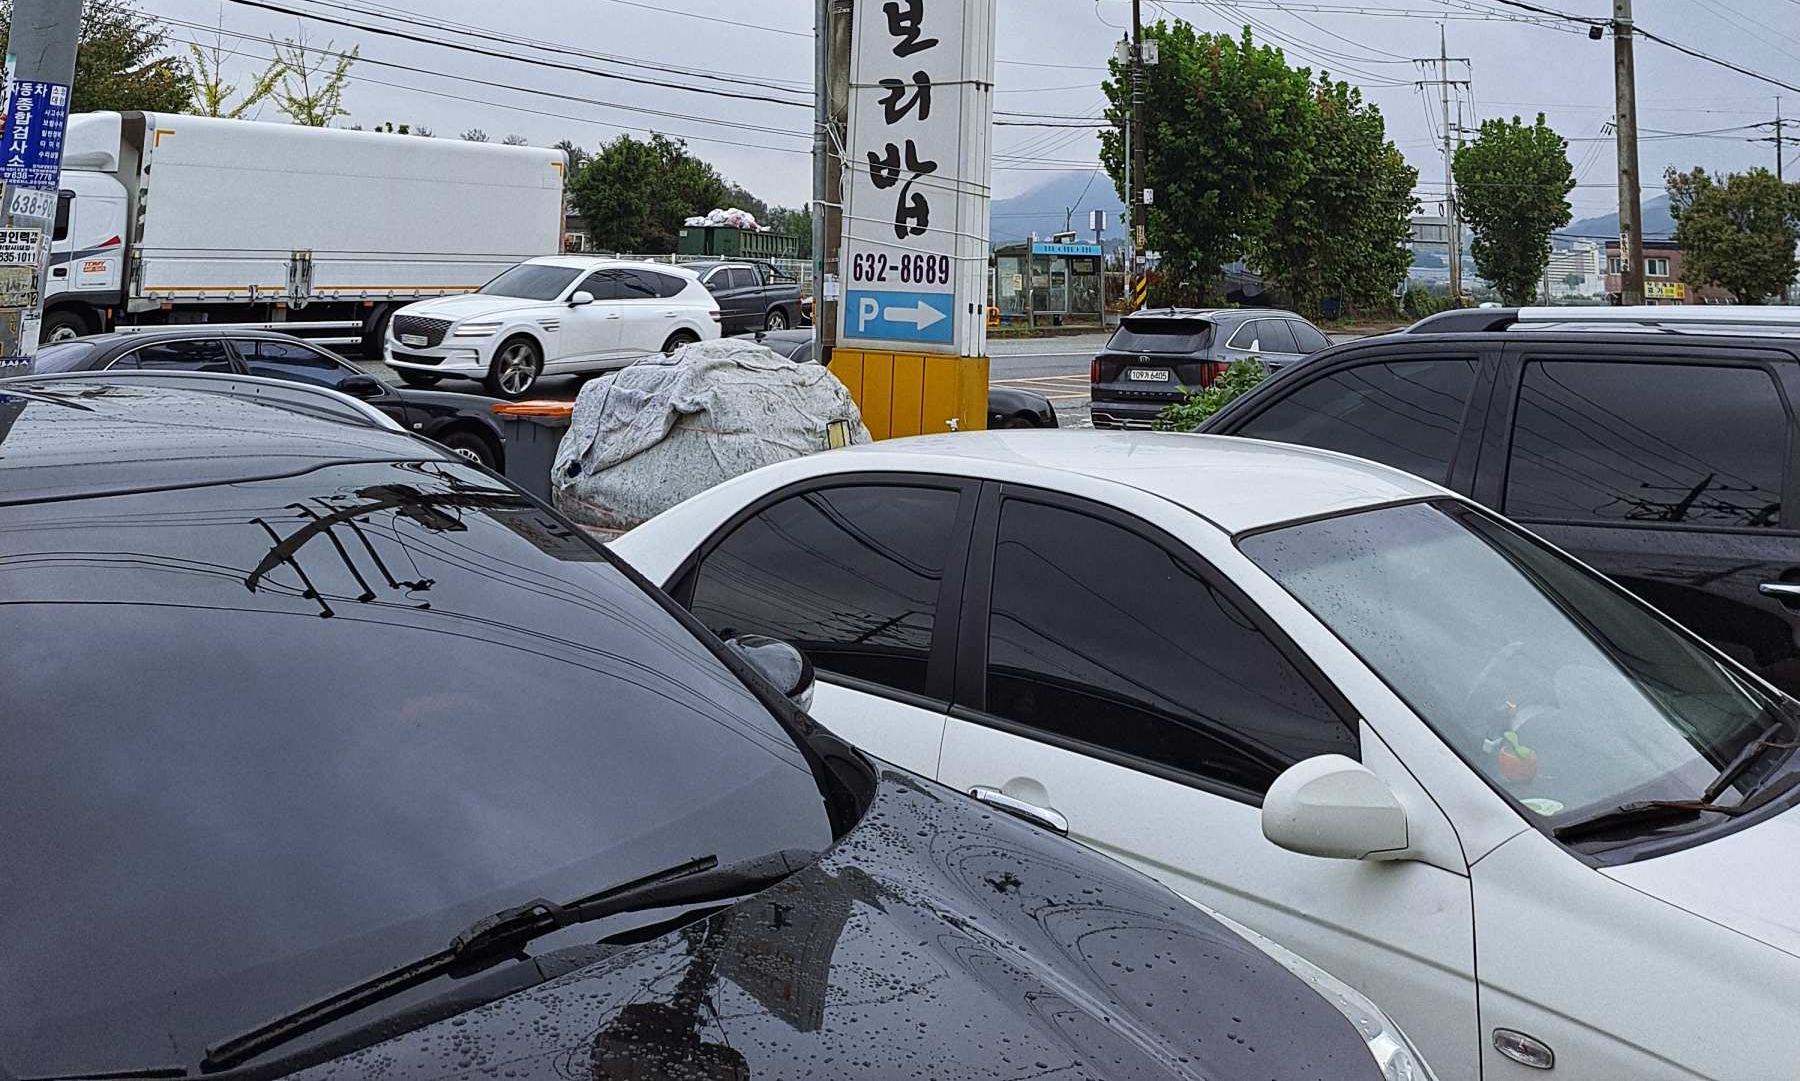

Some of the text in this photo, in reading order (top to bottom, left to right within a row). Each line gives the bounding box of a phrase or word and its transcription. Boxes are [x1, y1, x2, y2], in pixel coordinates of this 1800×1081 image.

[6, 97, 34, 168] 종합검사소
[853, 253, 950, 285] 632-8689
[858, 297, 880, 333] P
